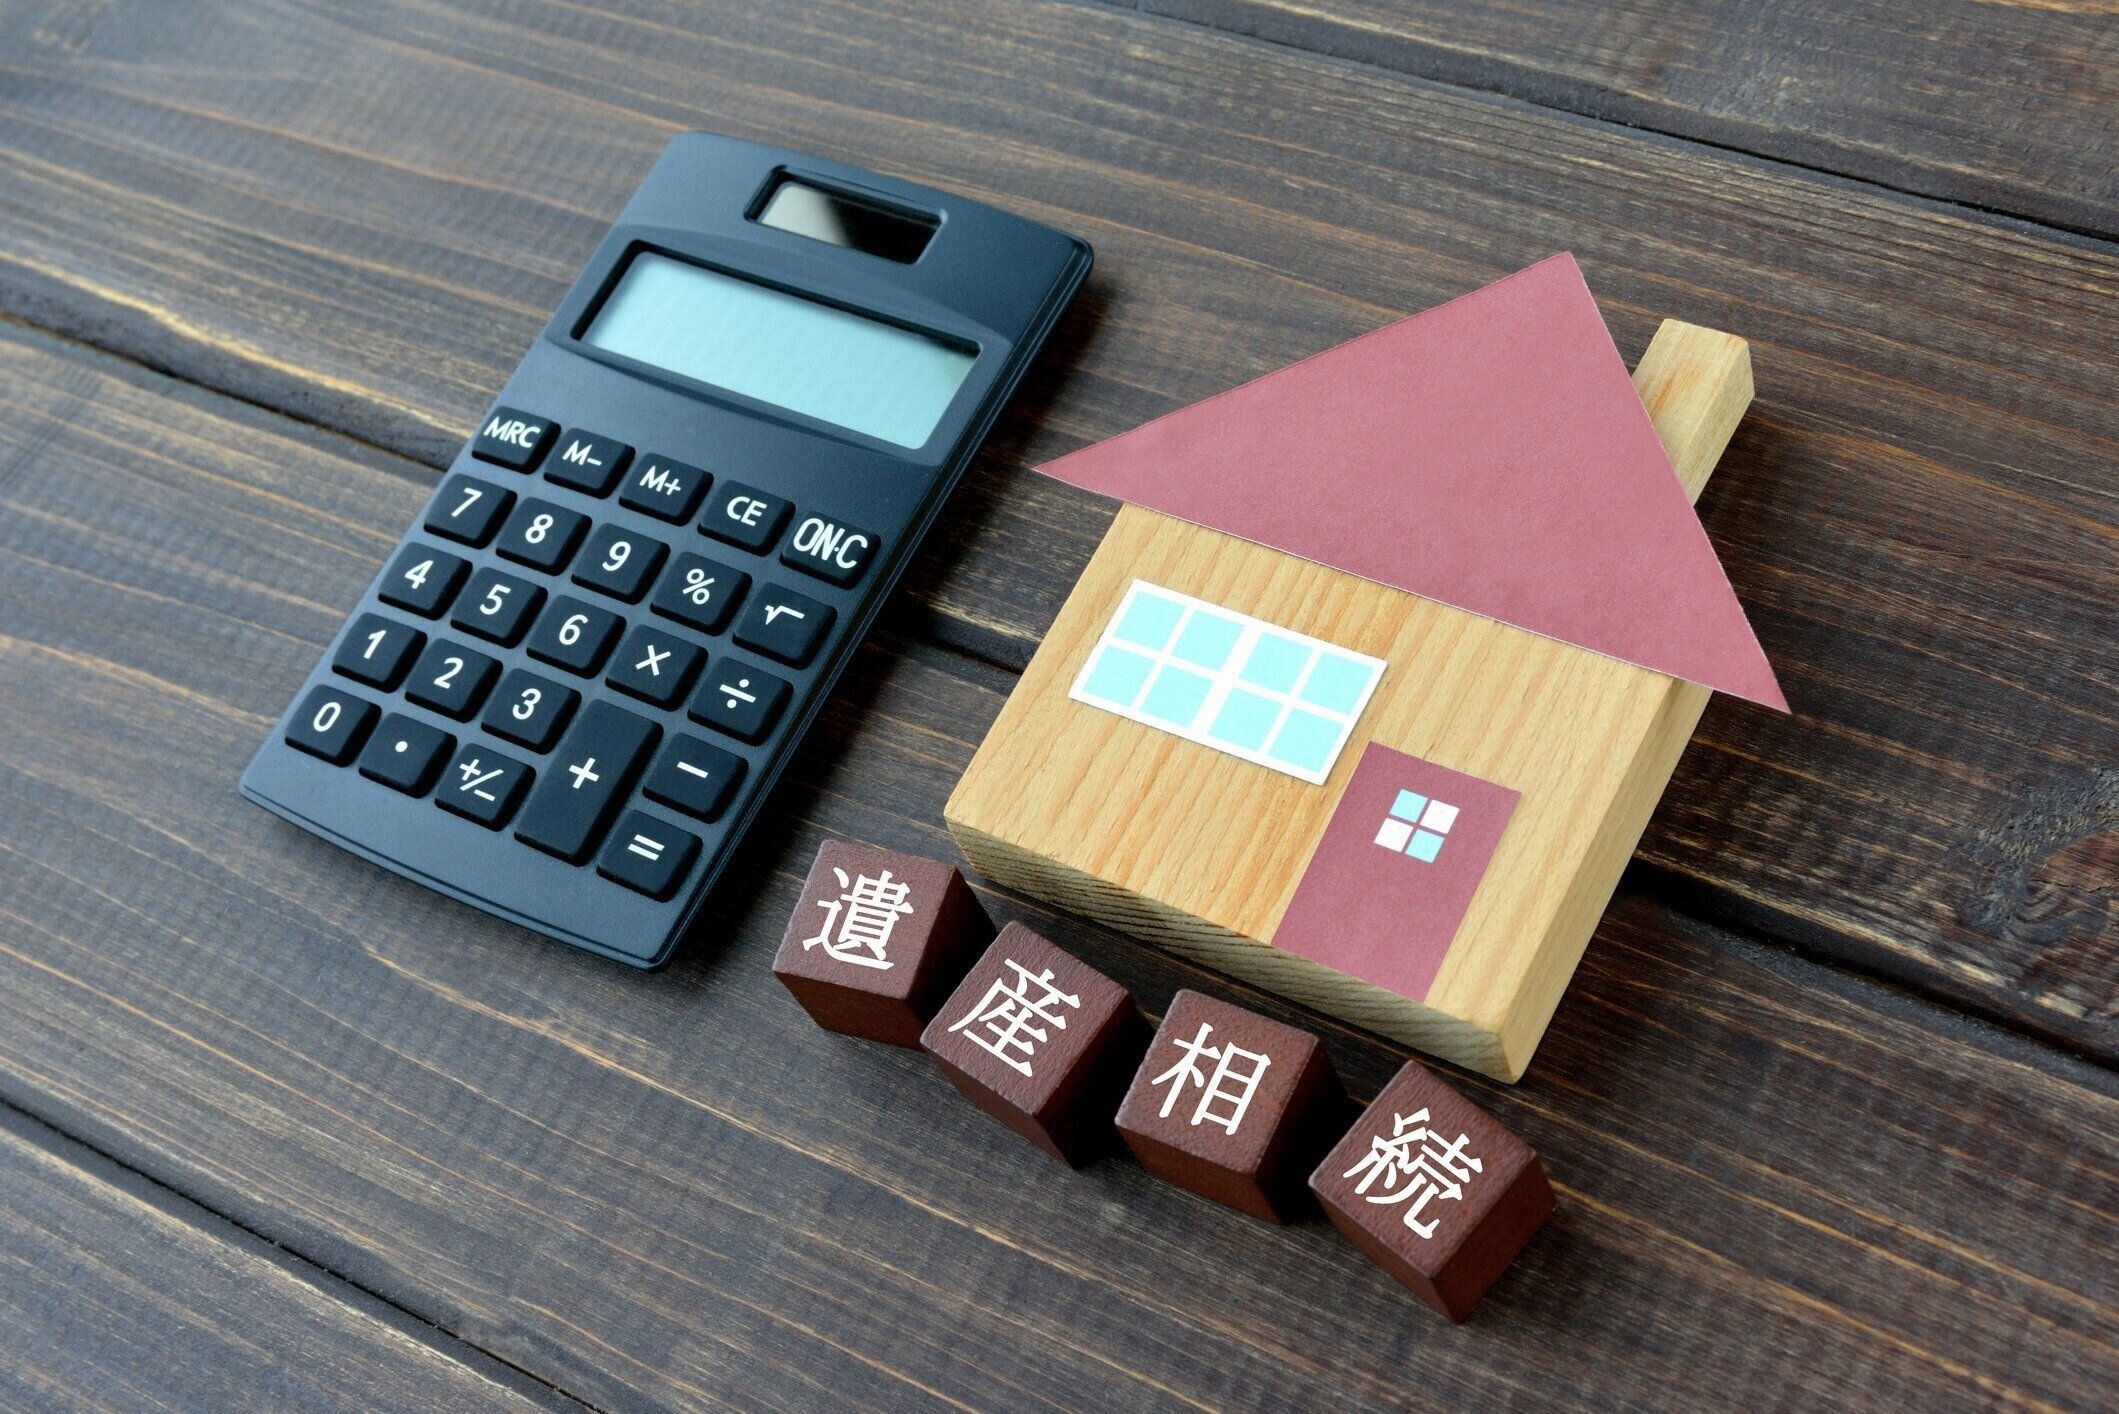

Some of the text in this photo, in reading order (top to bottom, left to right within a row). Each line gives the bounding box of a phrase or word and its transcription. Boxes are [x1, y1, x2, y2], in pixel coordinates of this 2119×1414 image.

[483, 416, 541, 449] MRC
[639, 465, 682, 496] M+
[451, 487, 483, 518] 7
[726, 496, 768, 527] CE
[525, 513, 554, 544] 8
[602, 541, 632, 572] 9
[404, 559, 434, 590] 4
[682, 568, 715, 605] %
[479, 583, 512, 616] 5
[363, 629, 387, 659] 1
[558, 614, 589, 646] 6
[433, 657, 464, 689] 2
[313, 701, 342, 732] 0
[512, 688, 542, 720] 3
